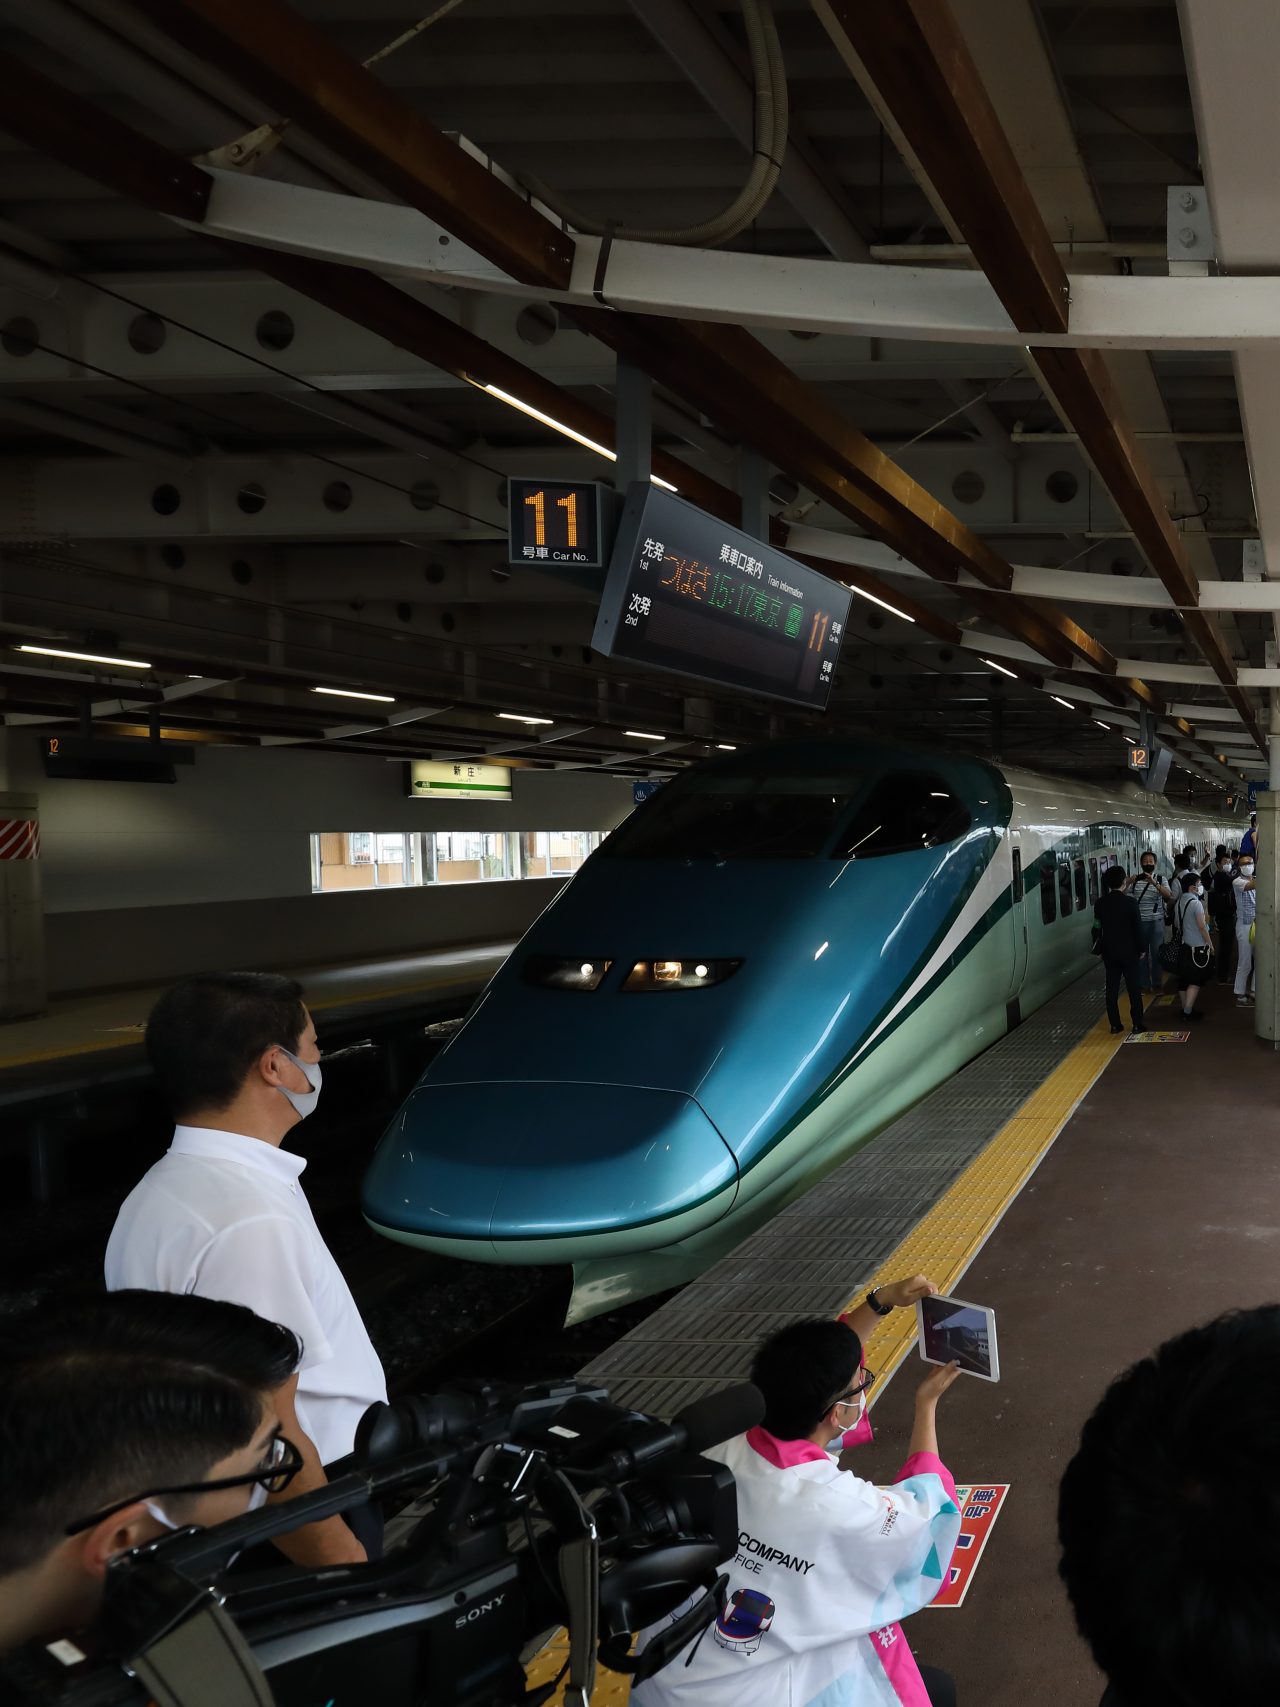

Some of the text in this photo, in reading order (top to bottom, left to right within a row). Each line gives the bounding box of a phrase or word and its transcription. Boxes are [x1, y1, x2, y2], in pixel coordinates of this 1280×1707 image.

[524, 491, 577, 547] 11
[522, 546, 549, 559] 号車
[553, 551, 589, 562] Car No.
[642, 537, 665, 562] 先発
[639, 558, 649, 571] 1st
[719, 543, 764, 580] 乗車口案内
[661, 556, 711, 600] つばさ
[768, 574, 780, 588] Train
[628, 593, 652, 615] 次発
[624, 613, 639, 626] 2nd
[49, 738, 59, 753] 12
[1131, 750, 1146, 764] 12
[734, 1553, 764, 1575] FICE
[738, 1532, 815, 1575] COMPANY
[455, 1593, 506, 1629] SONY
[877, 1625, 898, 1649] 社
